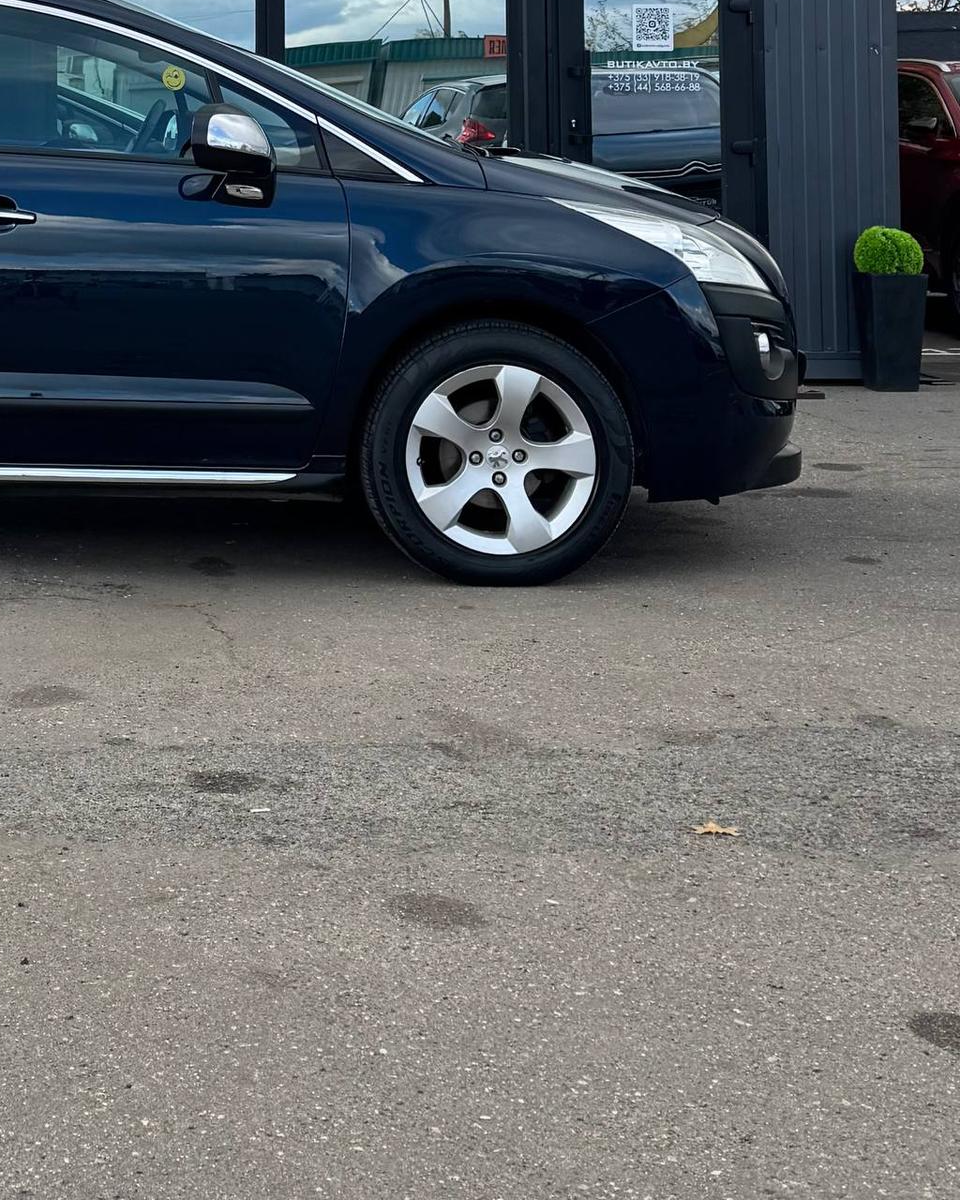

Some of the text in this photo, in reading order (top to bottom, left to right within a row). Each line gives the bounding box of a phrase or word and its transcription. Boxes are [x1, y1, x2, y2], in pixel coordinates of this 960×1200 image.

[607, 60, 700, 69] BUTIKAVTO.BY
[608, 73, 631, 82] +375
[608, 82, 701, 94] +375 (44) 568-66-88
